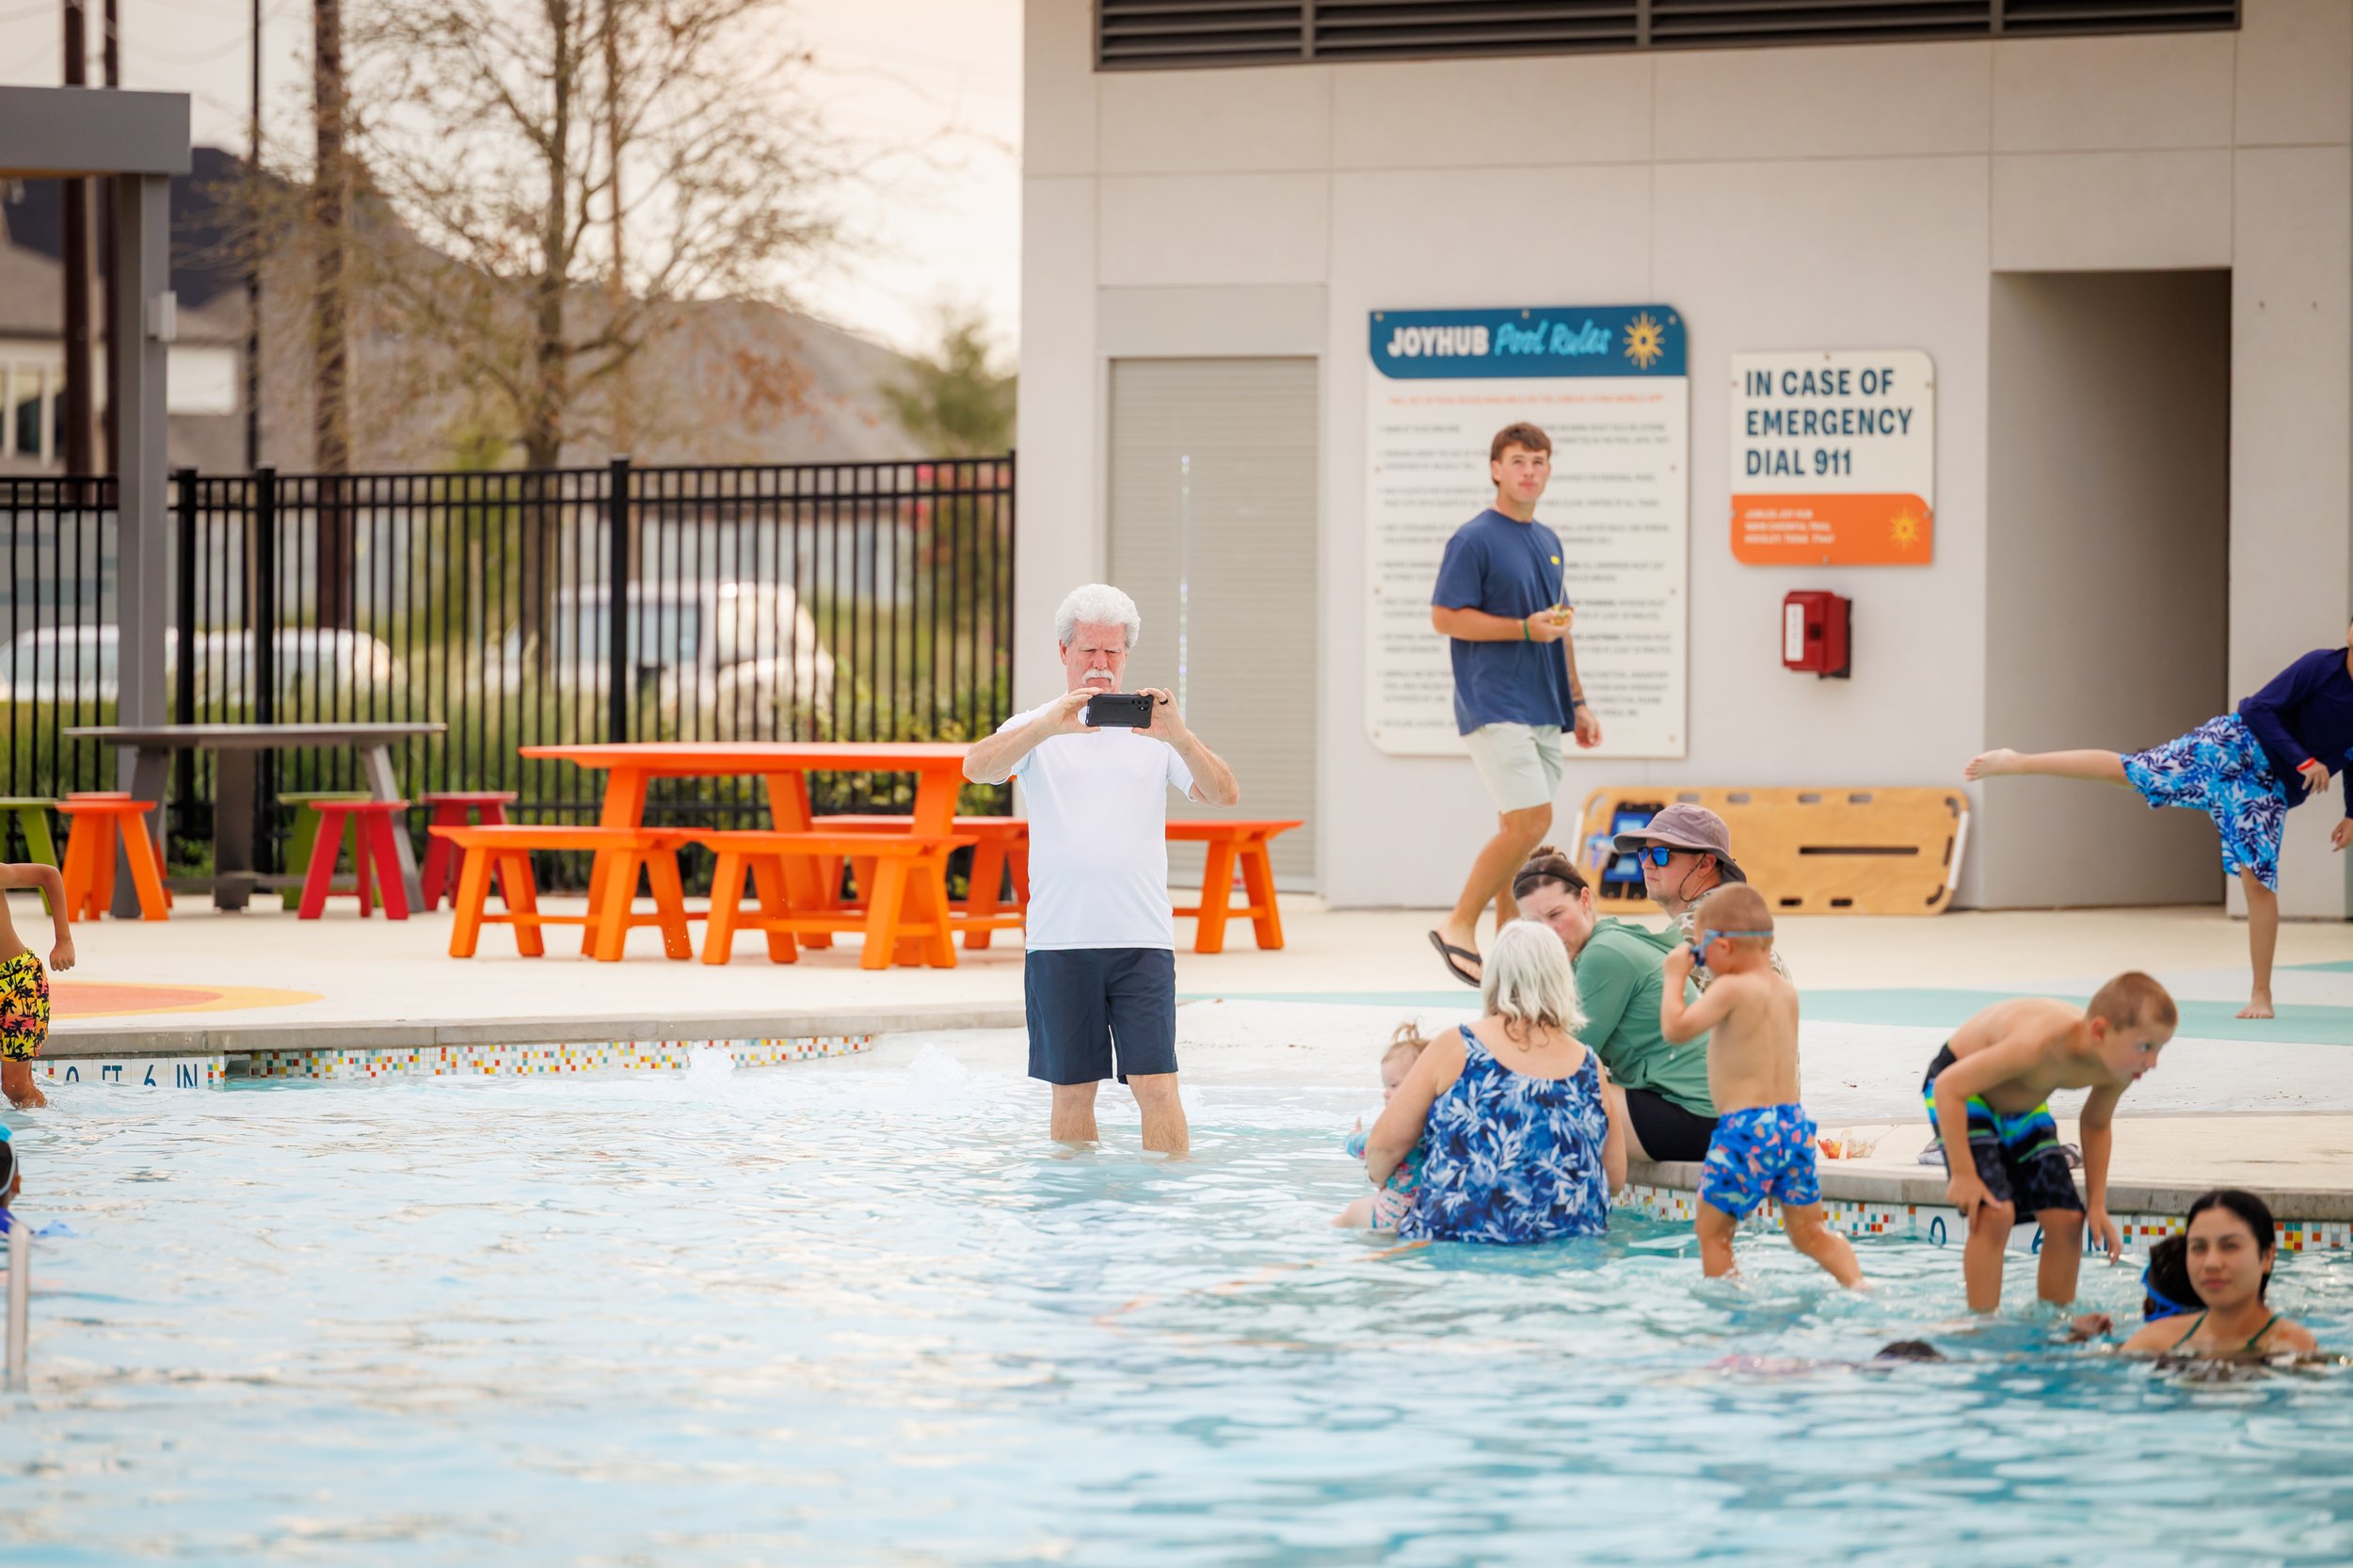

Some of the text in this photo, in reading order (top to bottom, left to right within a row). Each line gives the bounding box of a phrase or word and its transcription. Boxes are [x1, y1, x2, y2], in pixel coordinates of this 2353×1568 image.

[1495, 318, 1549, 357] Pool
[1549, 318, 1613, 357] Rules
[1746, 368, 1895, 397] IN CASE OF
[1746, 408, 1913, 436] EMERGENCY
[1746, 449, 1851, 475] DIAL 911
[143, 1064, 157, 1087] 6
[176, 1064, 198, 1089] IN
